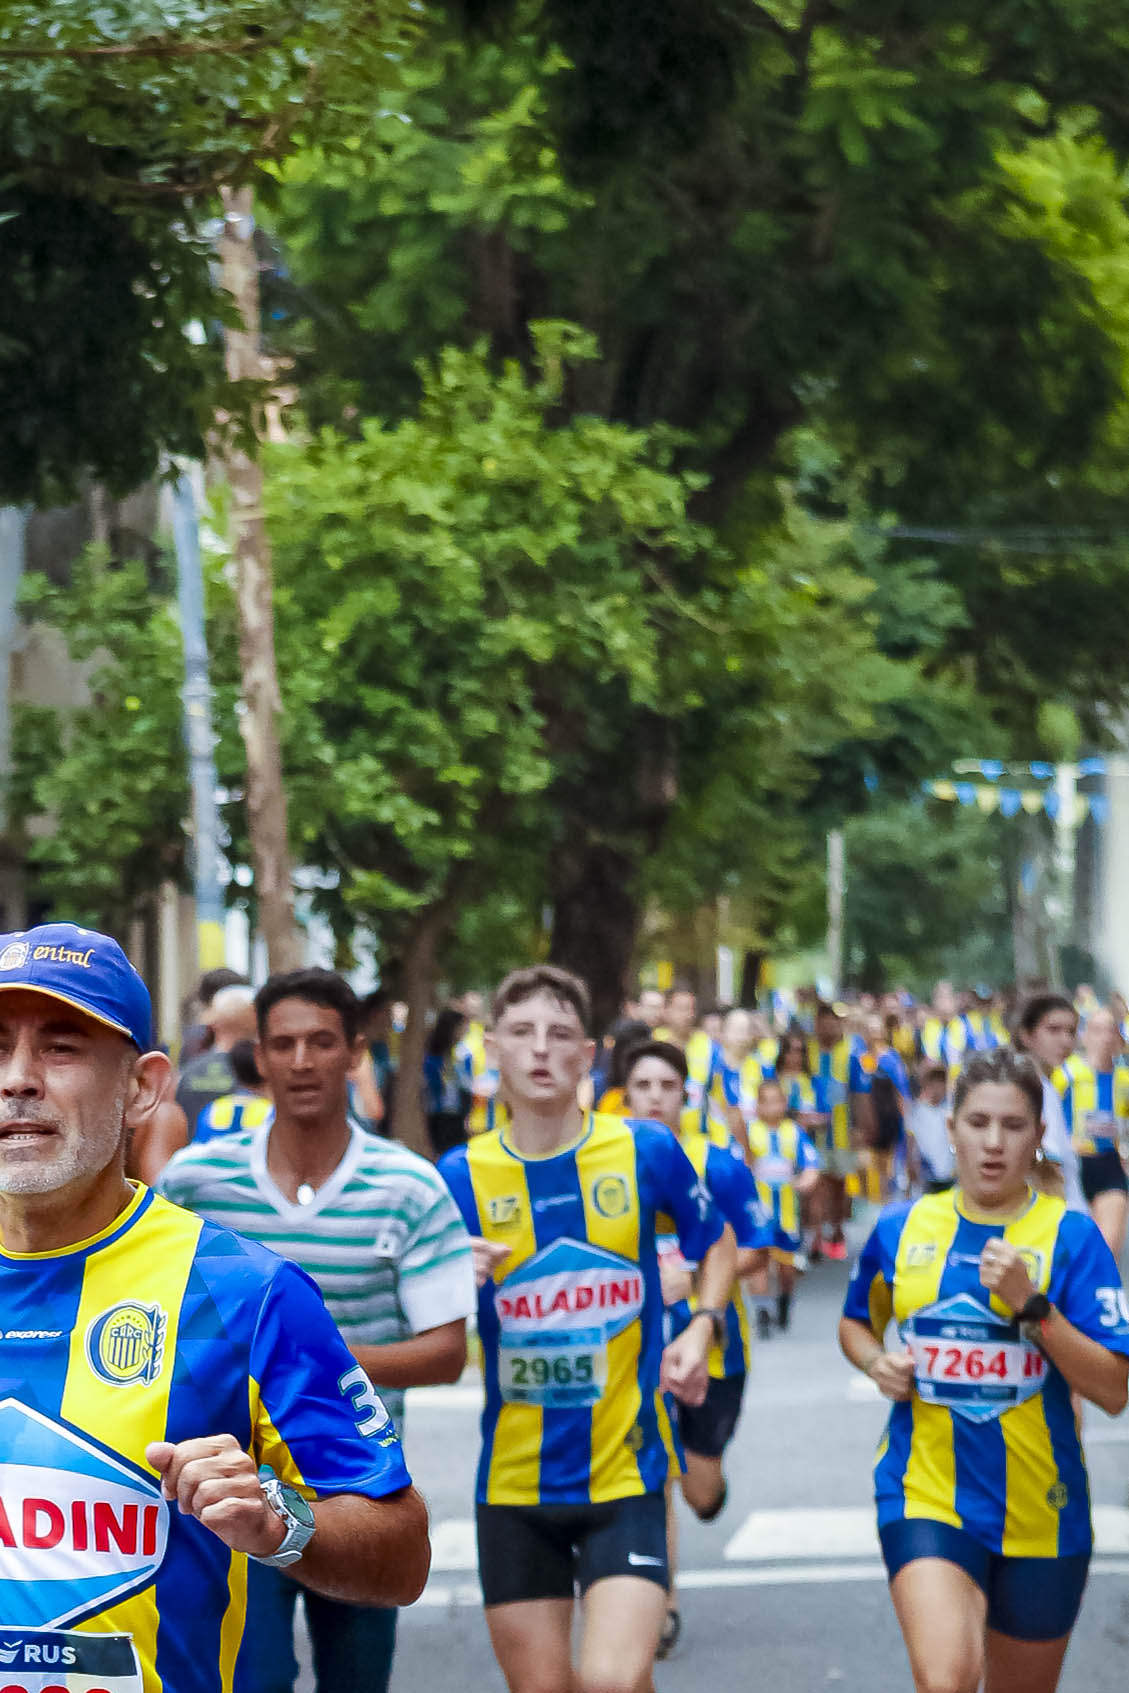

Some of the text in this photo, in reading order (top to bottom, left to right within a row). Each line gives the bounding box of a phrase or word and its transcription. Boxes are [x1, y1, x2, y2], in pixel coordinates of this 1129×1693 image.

[510, 1355, 594, 1385] 2965
[924, 1346, 1008, 1379] 7264
[24, 1644, 76, 1665] RUS
